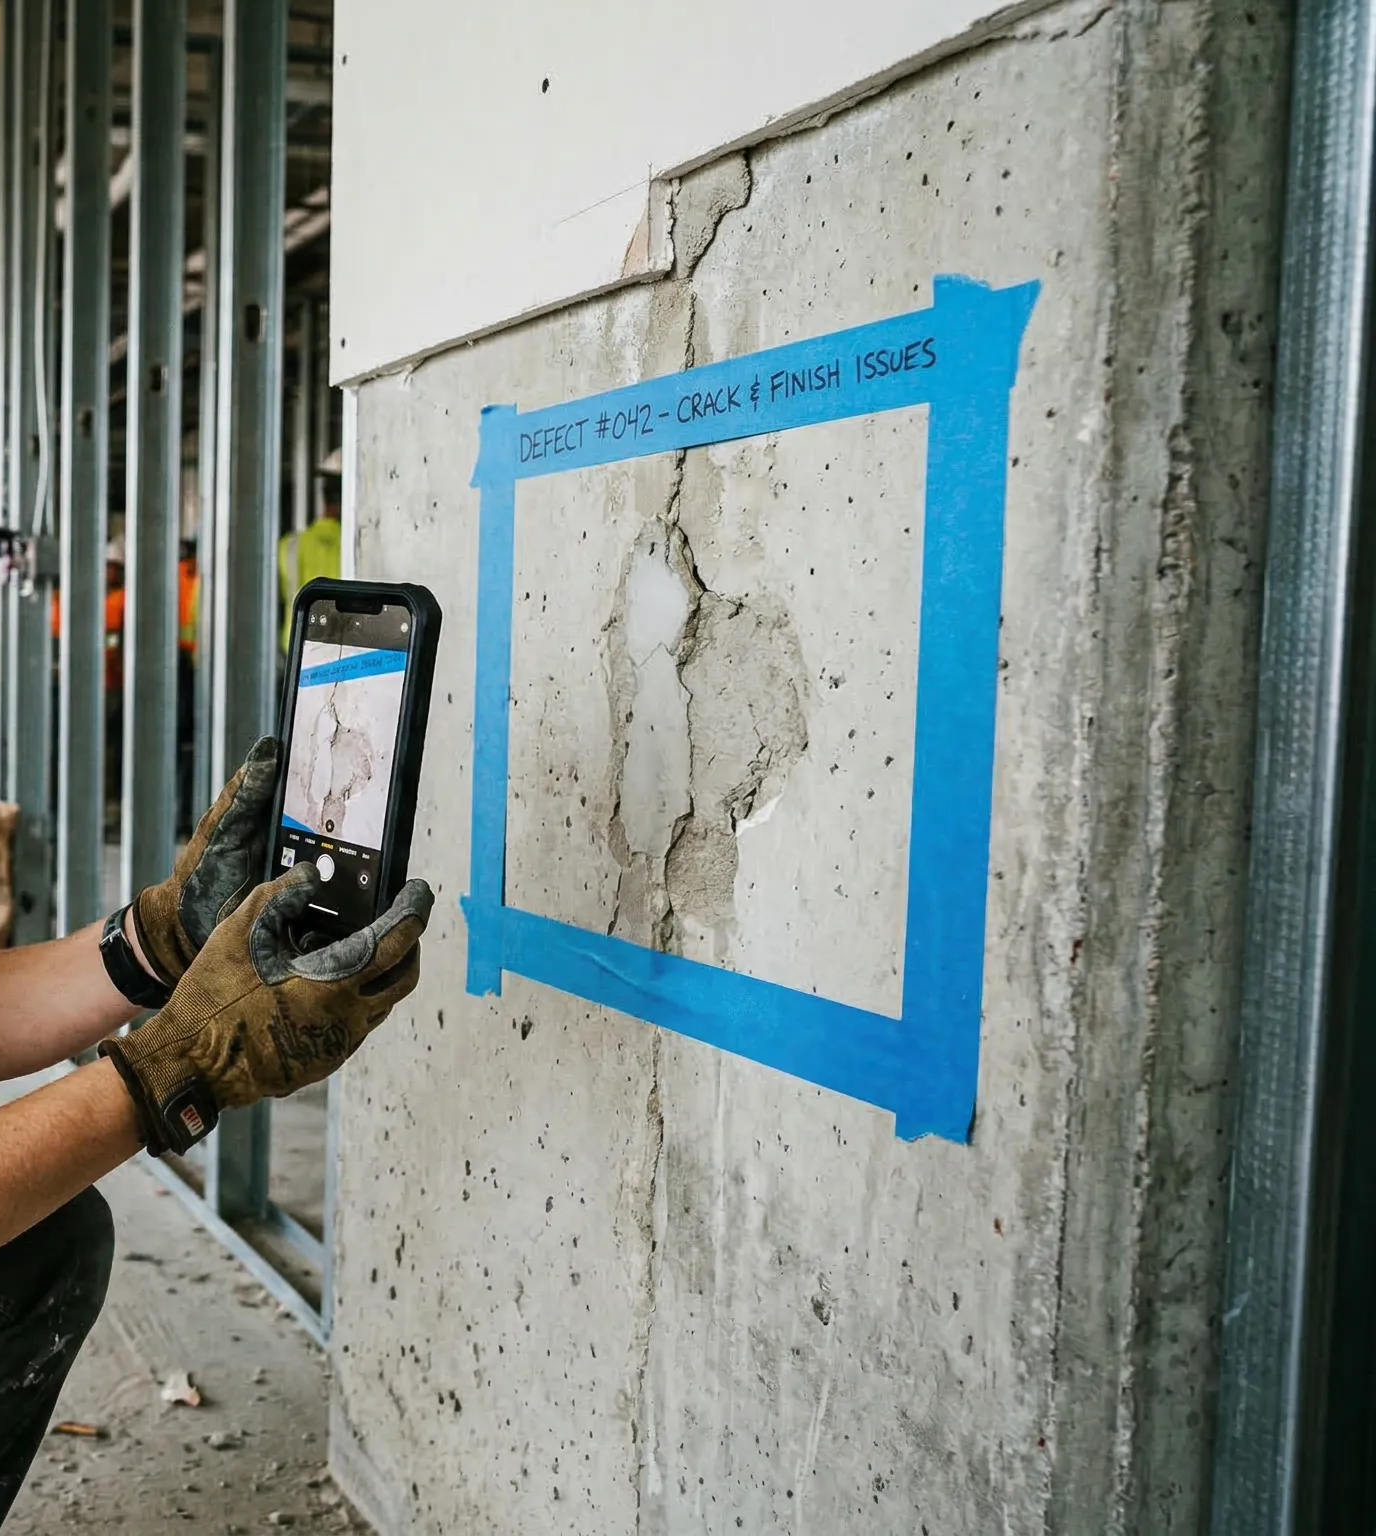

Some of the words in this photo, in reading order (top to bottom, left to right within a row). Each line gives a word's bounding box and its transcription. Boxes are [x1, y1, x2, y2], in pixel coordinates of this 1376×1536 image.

[520, 418, 589, 463] DEFECT
[594, 404, 654, 441] #042
[676, 384, 742, 424] CRACK
[750, 374, 760, 412] &
[770, 358, 841, 403] FINISH
[856, 337, 937, 383] ISSUES
